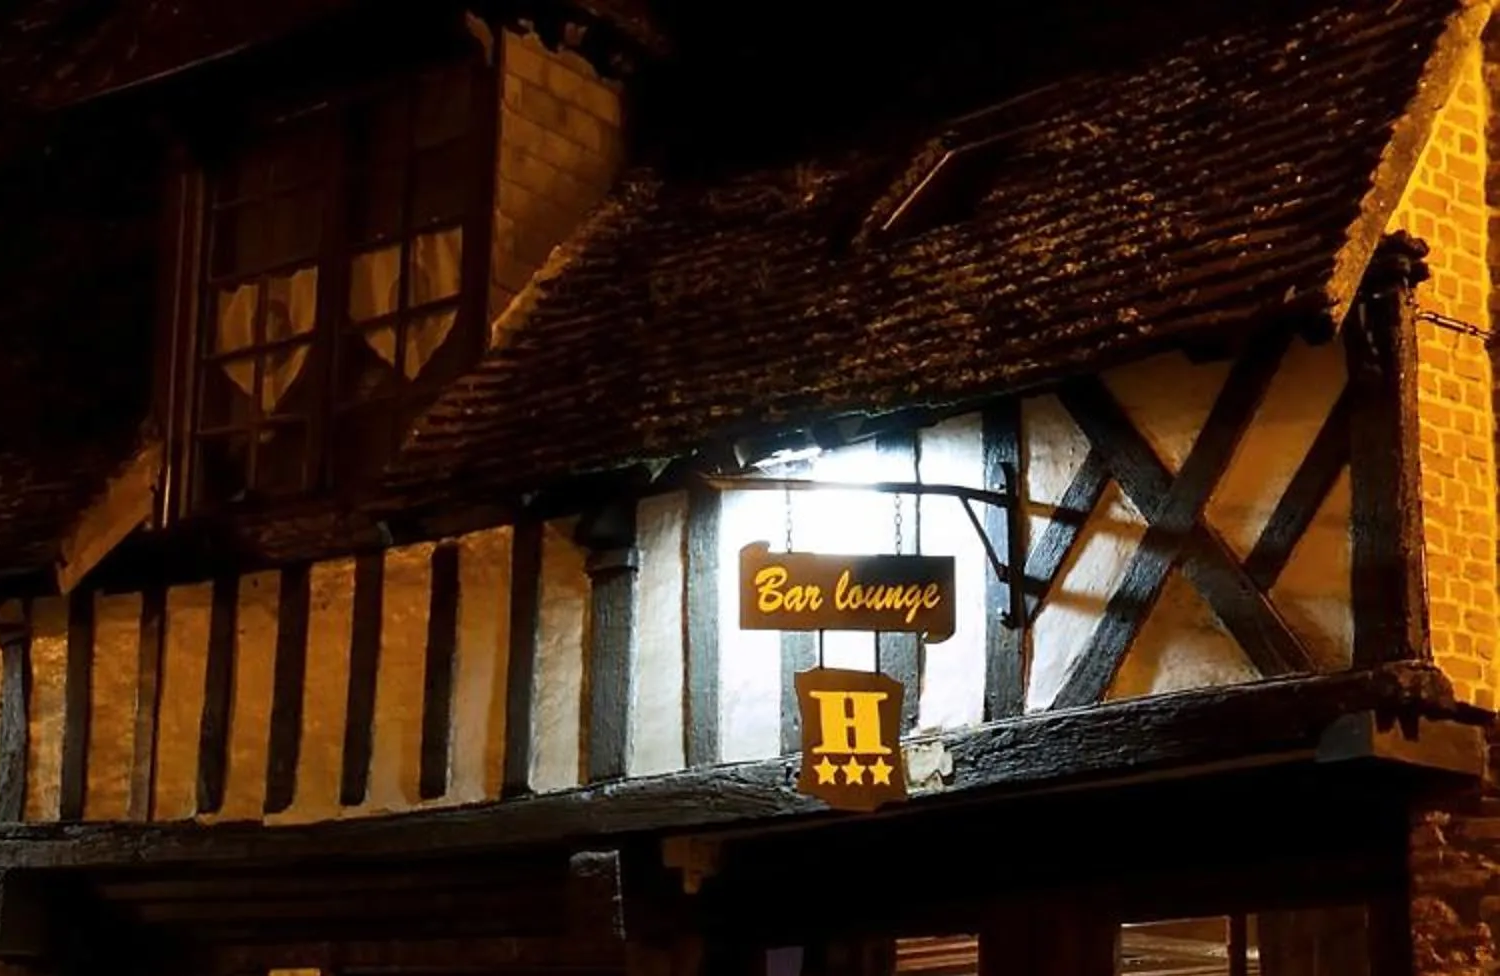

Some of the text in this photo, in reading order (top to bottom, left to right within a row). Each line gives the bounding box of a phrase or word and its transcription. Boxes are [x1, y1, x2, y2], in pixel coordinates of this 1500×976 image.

[755, 566, 941, 623] Bar lounge
[809, 690, 893, 755] H
